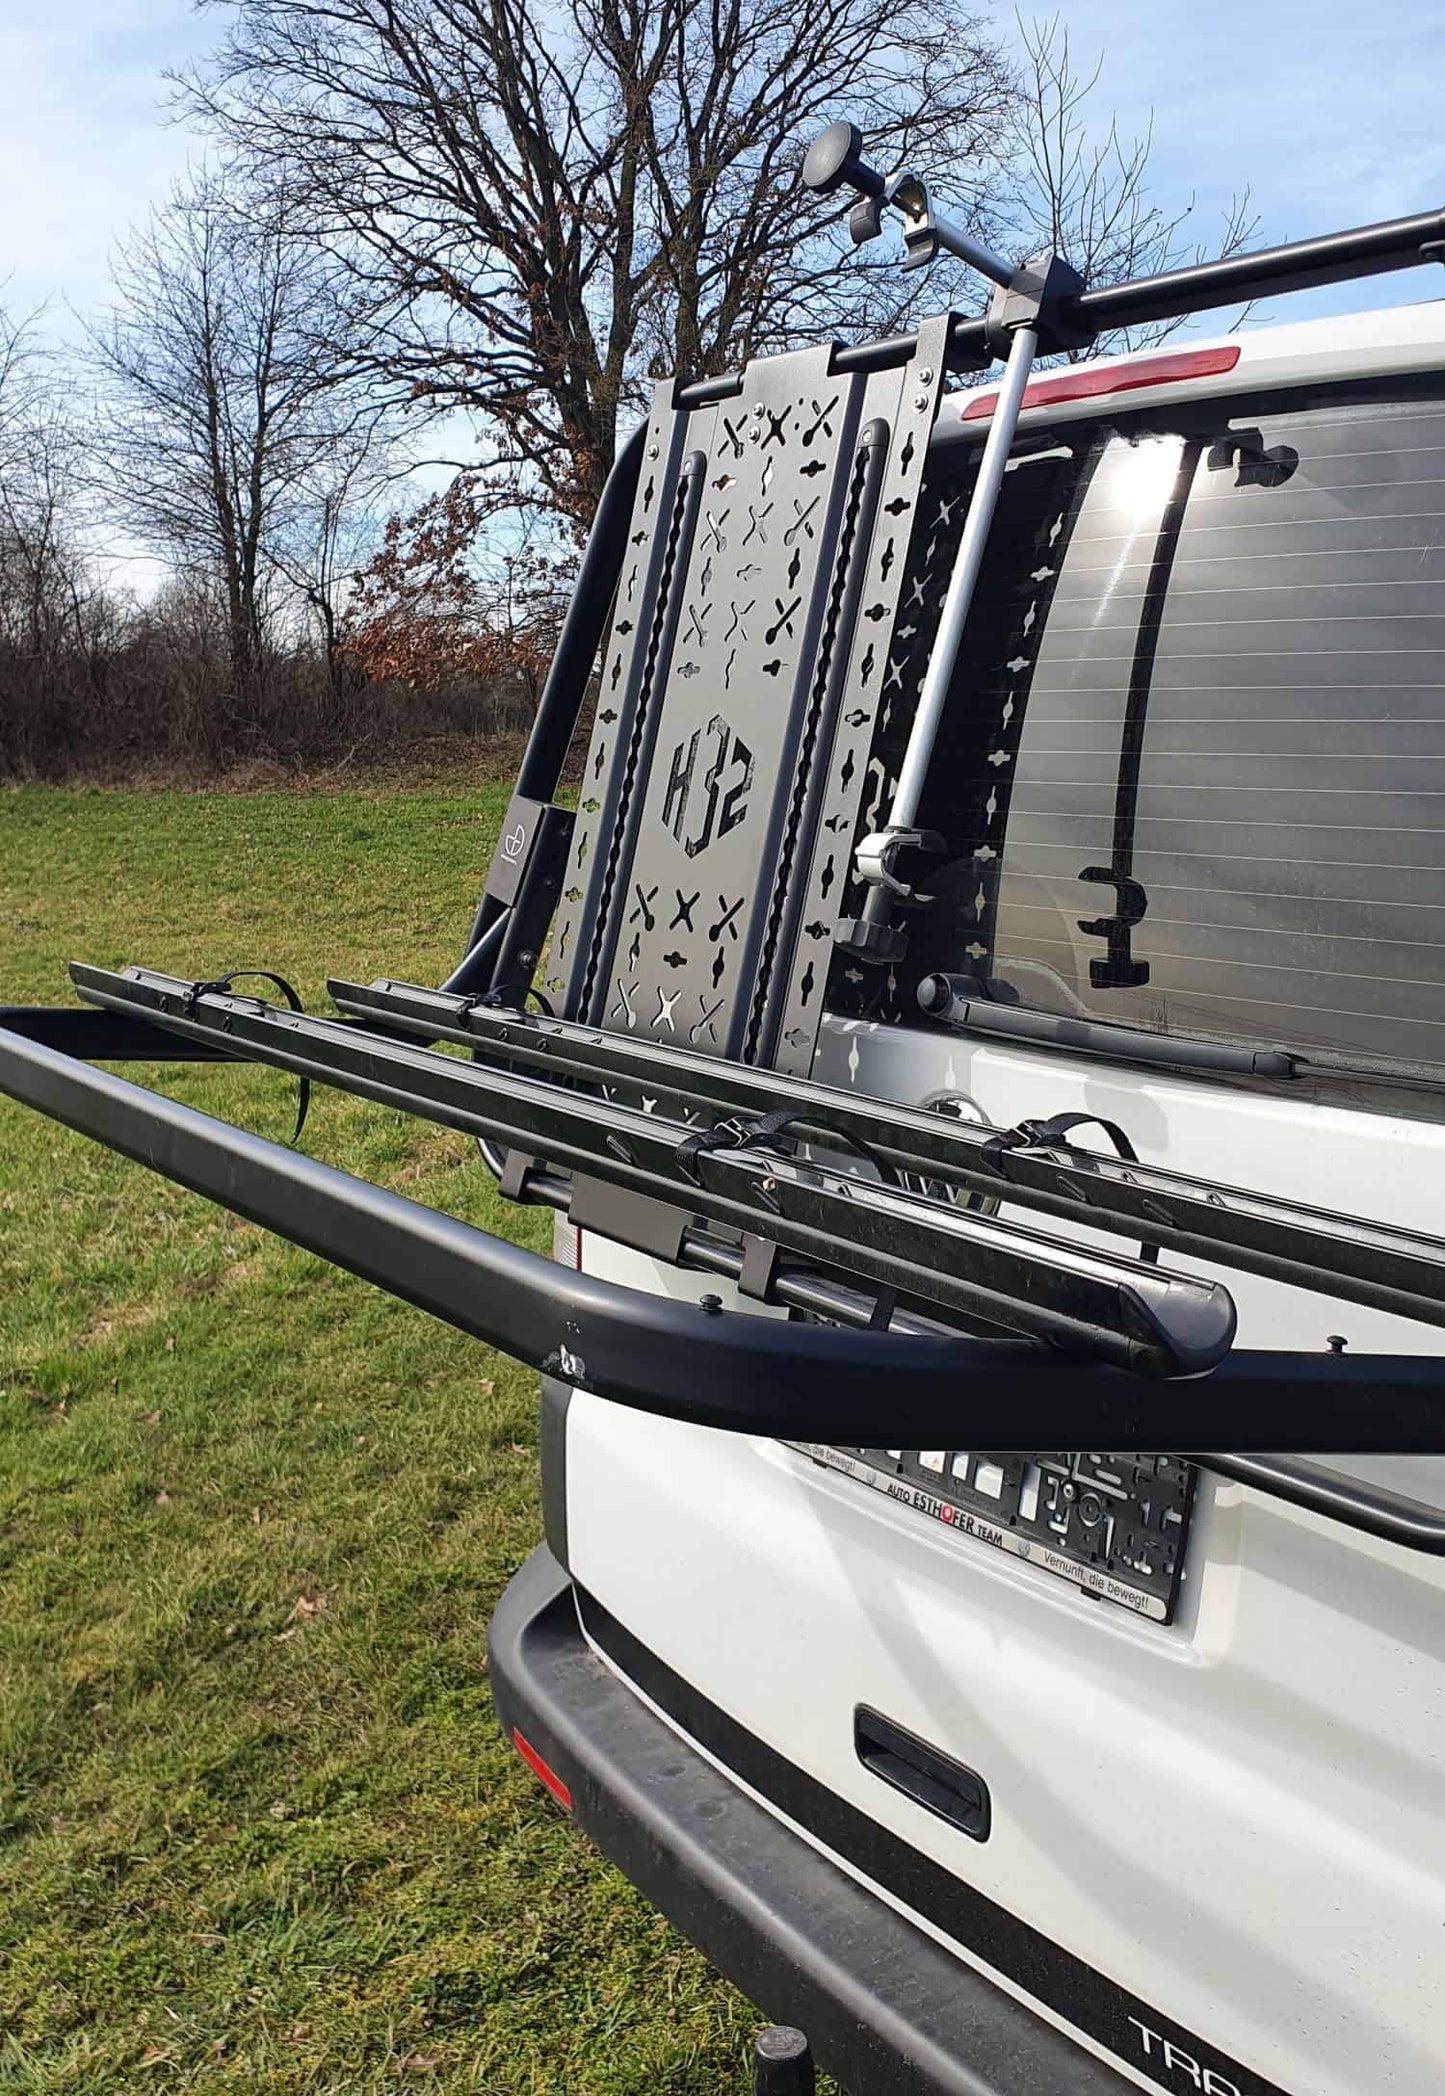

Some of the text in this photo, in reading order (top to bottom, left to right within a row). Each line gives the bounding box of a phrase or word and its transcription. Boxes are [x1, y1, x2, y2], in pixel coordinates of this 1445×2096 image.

[887, 1484, 1003, 1546] AUTO ESTHOFER TEAM
[1044, 1551, 1149, 1610] Vernunft, die bewegt!
